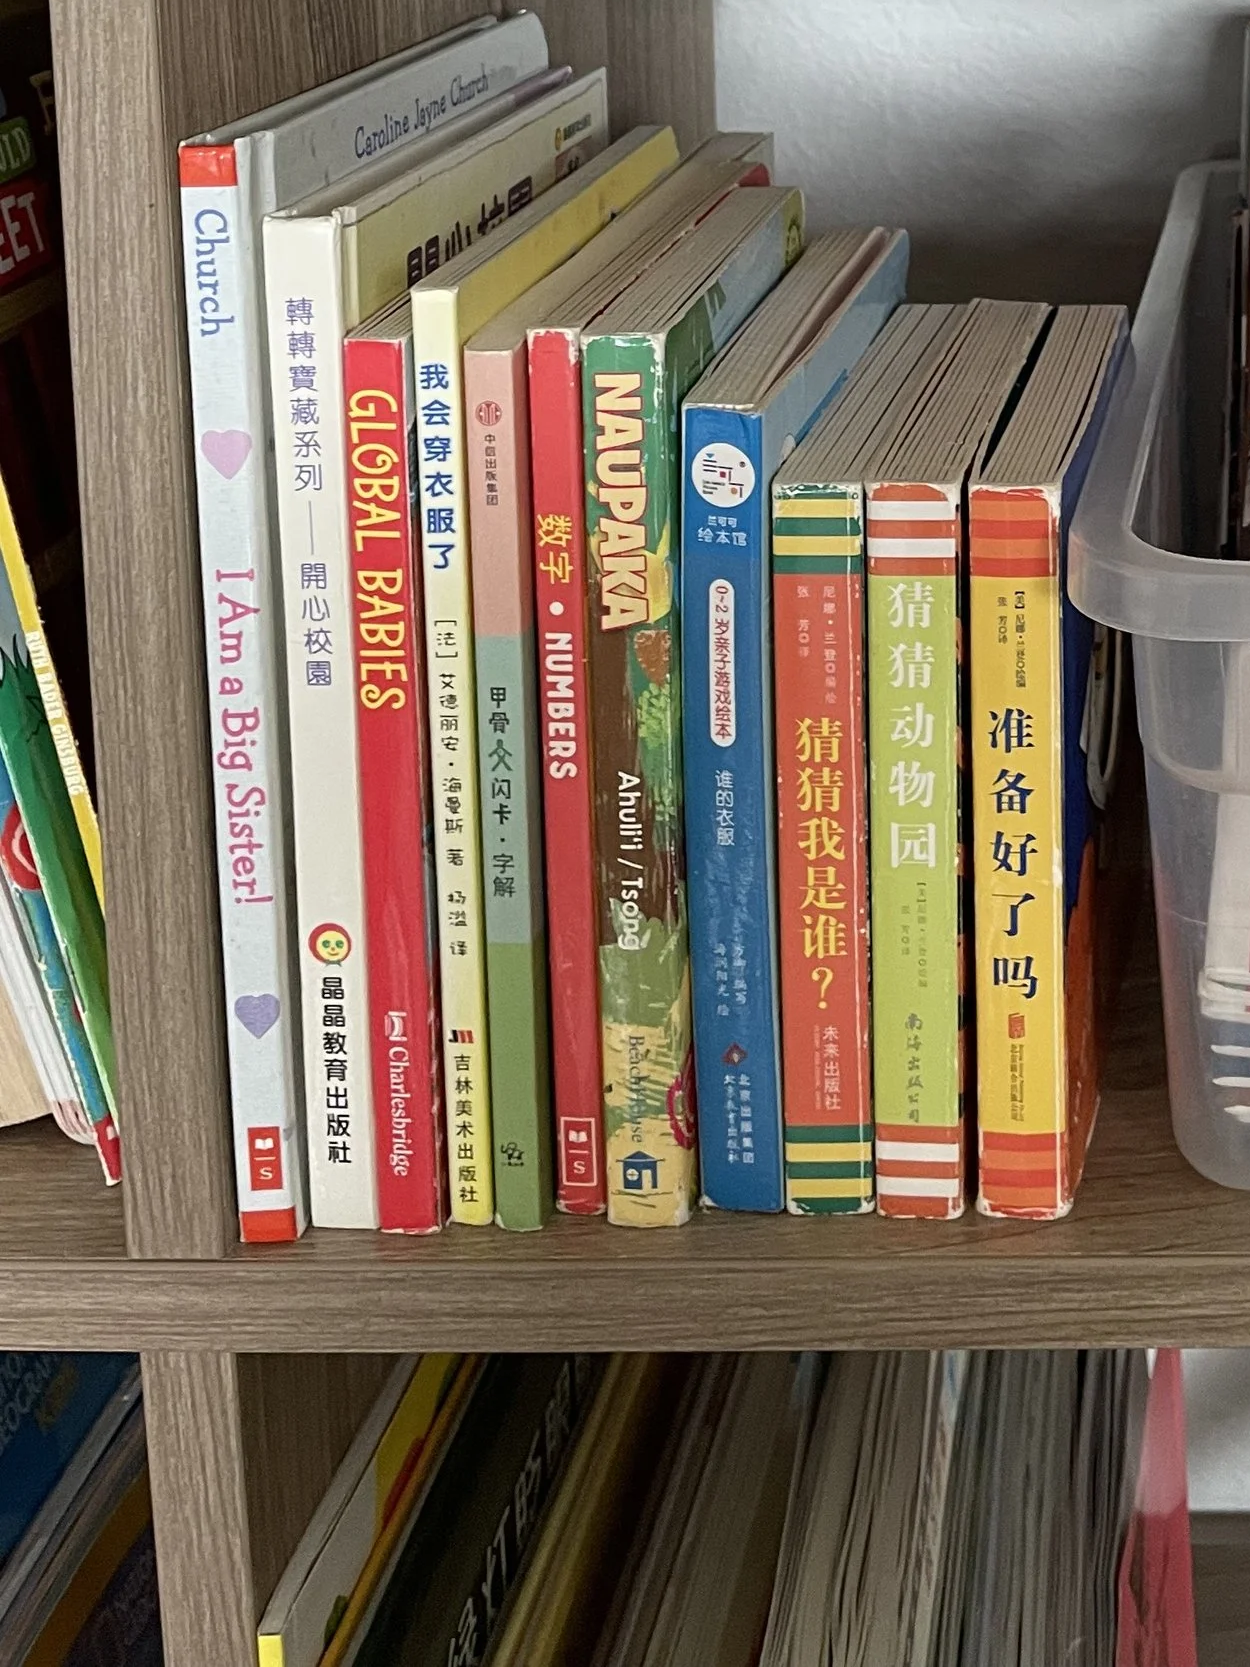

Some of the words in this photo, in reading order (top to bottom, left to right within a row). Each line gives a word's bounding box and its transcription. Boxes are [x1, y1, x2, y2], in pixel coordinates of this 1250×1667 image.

[355, 113, 410, 159] Caroline
[413, 96, 448, 134] Jayne
[449, 63, 490, 107] Church
[193, 208, 236, 337] Church
[349, 387, 402, 553] GLOBAL
[420, 362, 457, 570] 我会穿衣服了
[483, 433, 499, 507] 中信出版集团
[593, 372, 650, 632] NAUPAKA
[215, 568, 256, 583] I
[536, 514, 575, 584] 数字
[25, 630, 50, 668] RUTH
[217, 592, 262, 664] Am
[356, 568, 409, 711] BABIES
[37, 672, 65, 720] BADER
[218, 676, 244, 696] a
[545, 632, 578, 780] NUMBERS
[887, 581, 937, 869] 猜猜动物园
[50, 723, 85, 796] GINSBURG
[216, 706, 262, 772] Big
[224, 782, 275, 906] Sister!
[714, 769, 735, 847] 谁的衣服
[987, 707, 1039, 1000] 准备好了吗
[616, 877, 646, 951] Tsong
[795, 717, 849, 1010] 猜猜我是谁?
[449, 940, 468, 957] 译
[321, 976, 352, 1165] 晶晶教育出版社
[387, 1045, 412, 1177] Charlesbridge
[822, 1025, 841, 1112] 未来出版社
[904, 1011, 924, 1123] 南海出版公司
[453, 1053, 479, 1204] 吉林美术出版社
